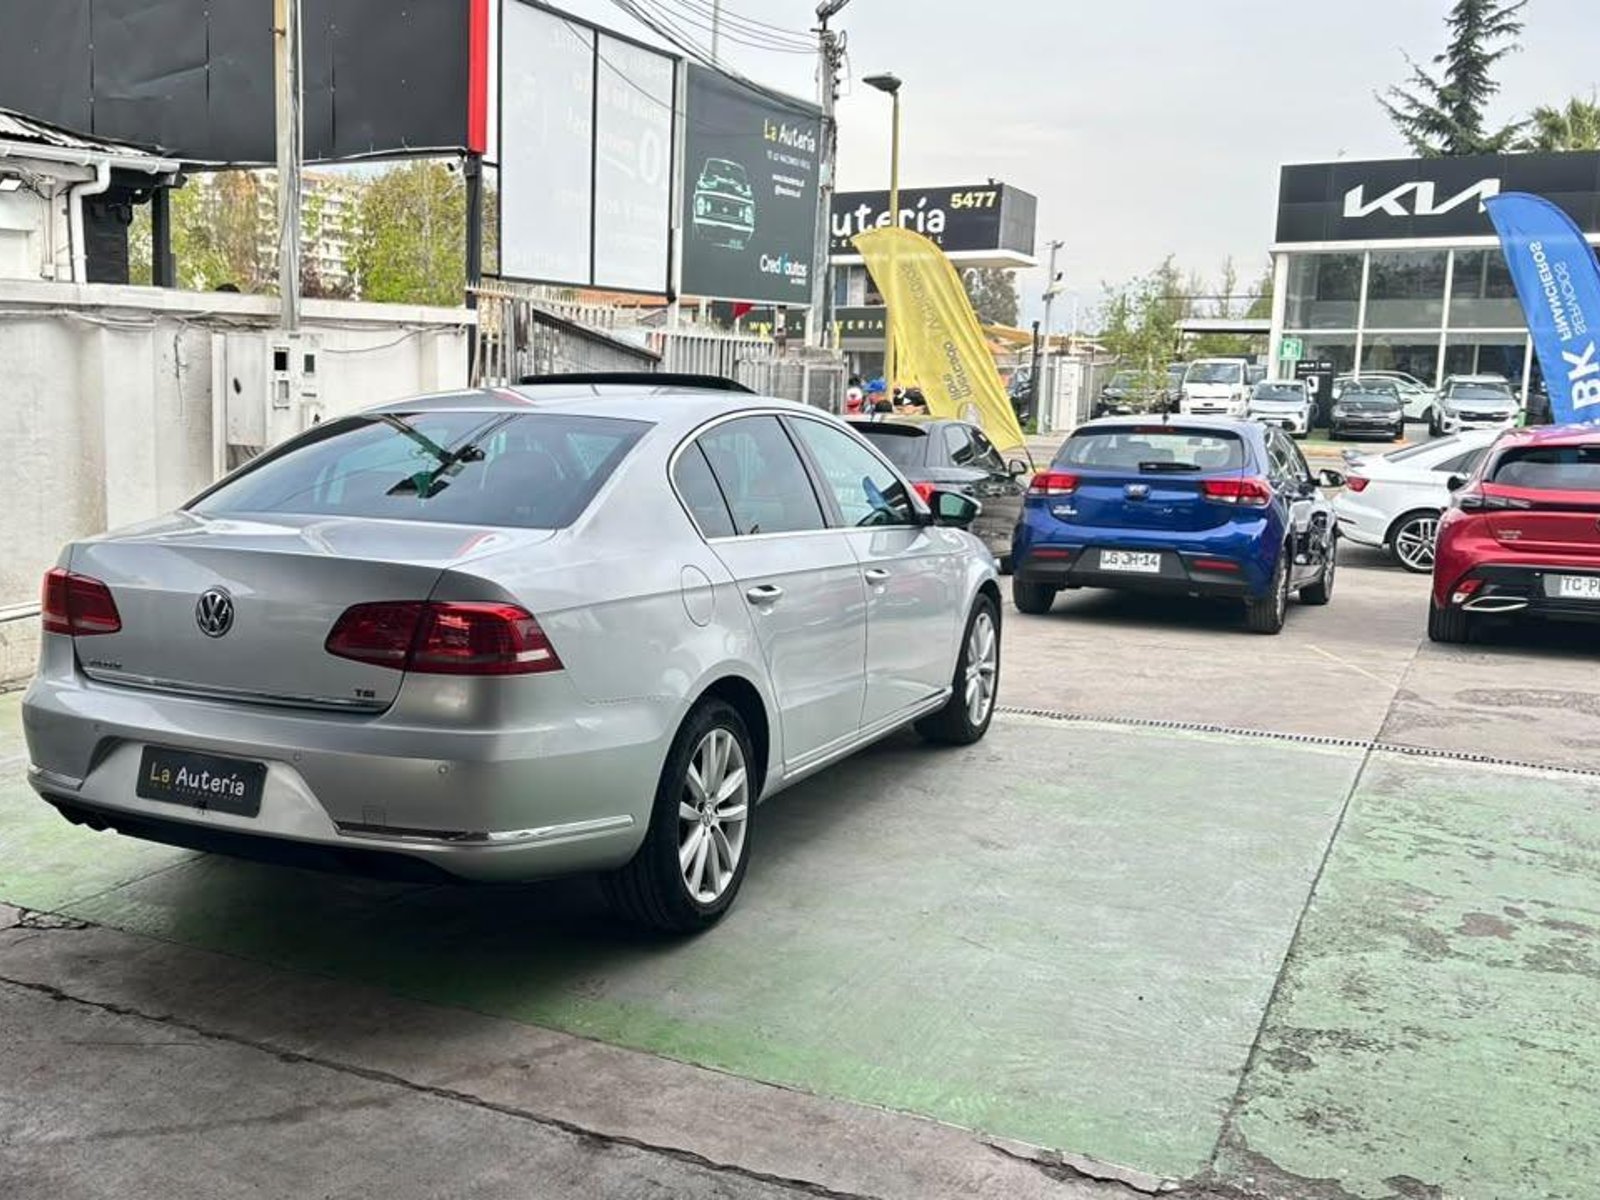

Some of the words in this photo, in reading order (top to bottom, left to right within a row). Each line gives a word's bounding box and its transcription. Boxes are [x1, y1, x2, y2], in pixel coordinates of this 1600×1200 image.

[764, 119, 777, 142] La
[950, 191, 997, 209] 5477
[831, 196, 946, 237] utería
[149, 762, 171, 783] La
[175, 766, 245, 796] Autería
